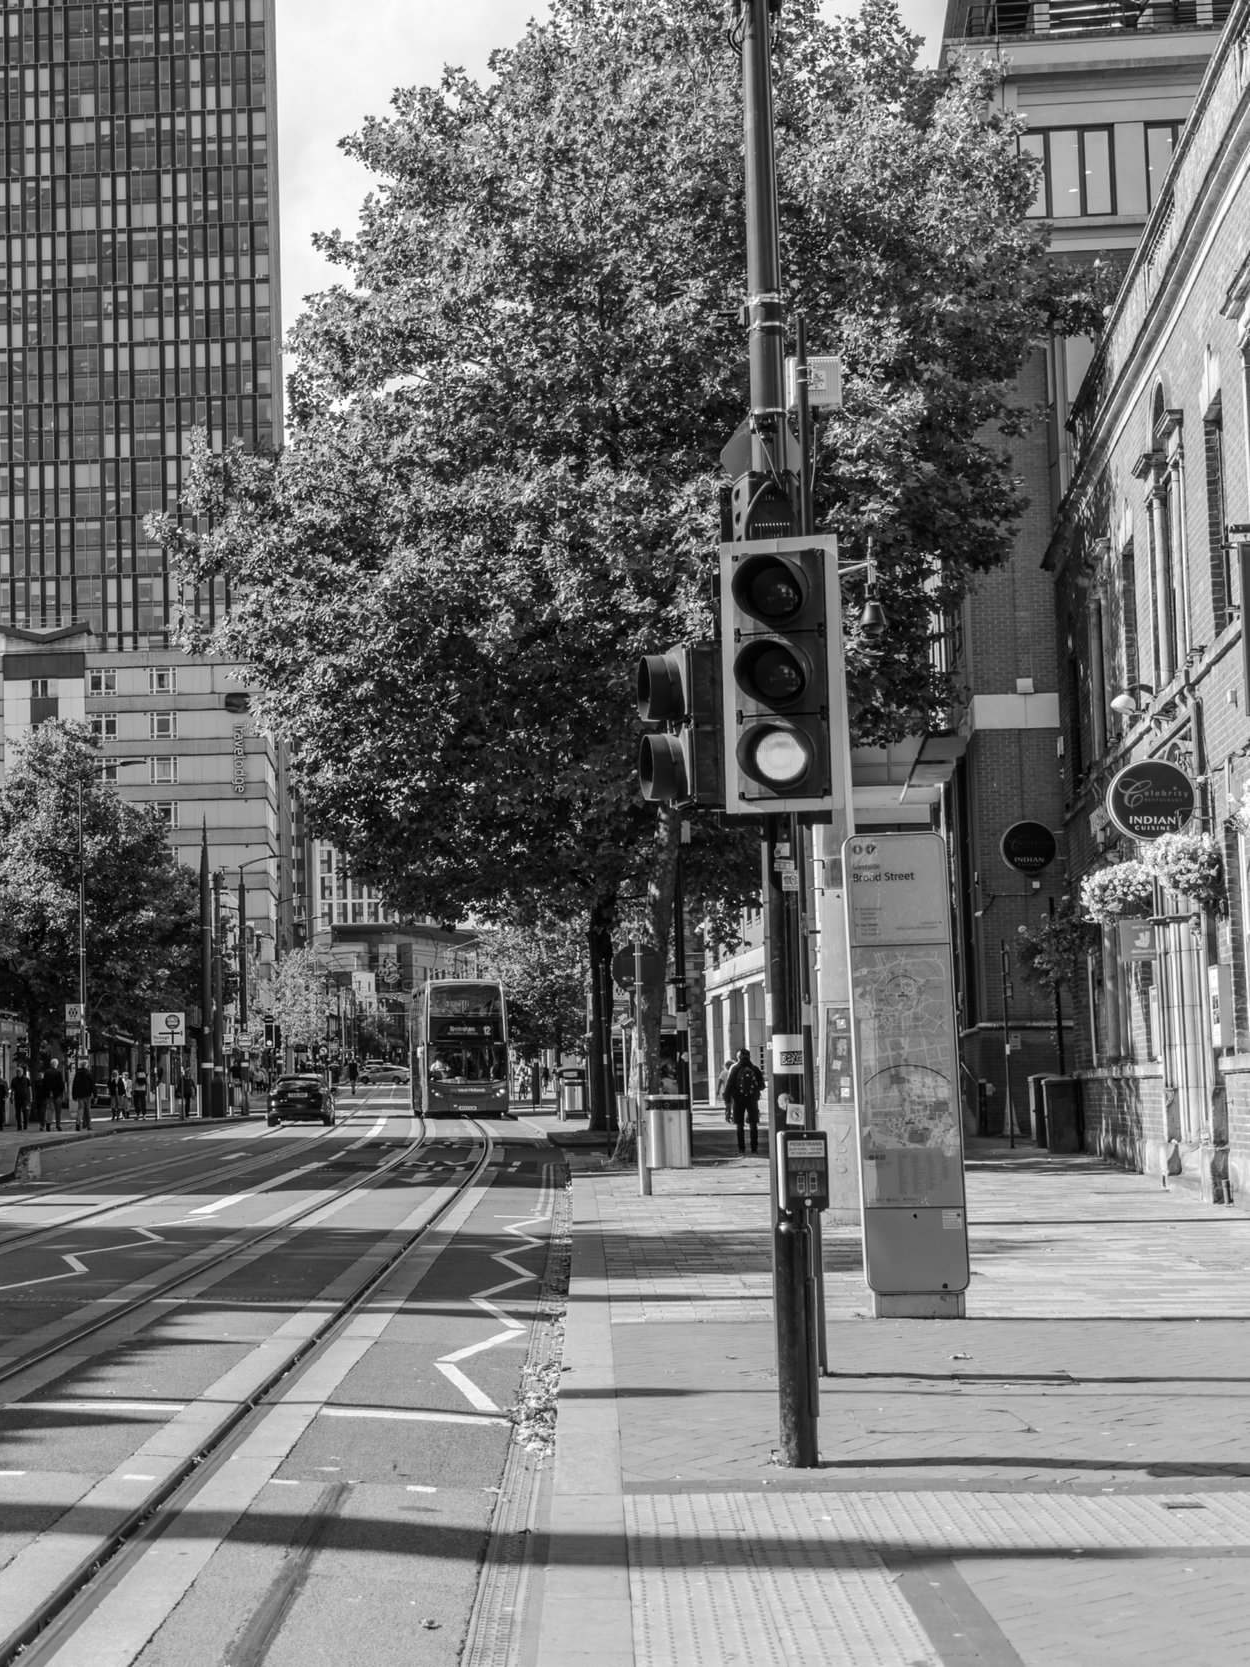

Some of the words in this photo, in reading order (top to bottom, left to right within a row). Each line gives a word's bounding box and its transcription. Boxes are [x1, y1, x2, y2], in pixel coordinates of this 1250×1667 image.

[231, 724, 247, 793] Travelodge
[1118, 778, 1189, 810] Celebrity
[1129, 815, 1177, 825] INDIAN
[853, 871, 882, 882] Broad
[884, 871, 915, 881] Street
[483, 1026, 491, 1035] 12
[790, 1159, 823, 1171] WAIT
